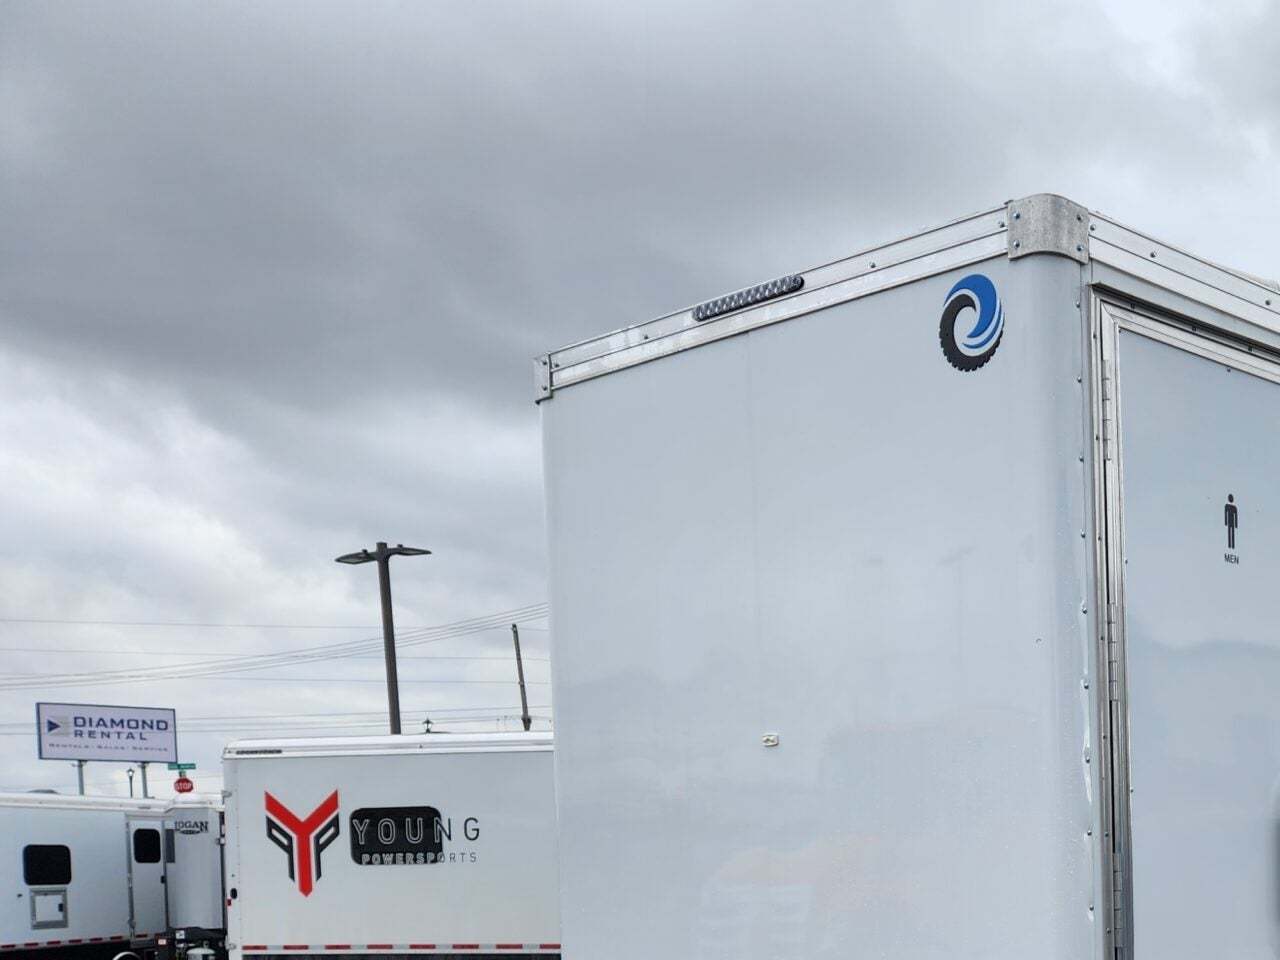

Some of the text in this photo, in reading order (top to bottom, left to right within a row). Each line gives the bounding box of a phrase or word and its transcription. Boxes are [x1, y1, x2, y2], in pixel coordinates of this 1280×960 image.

[1224, 552, 1239, 564] MEN
[73, 716, 169, 731] DIAMOND
[74, 730, 147, 741] RENTAL
[175, 782, 192, 790] STOP
[174, 820, 209, 833] LOGAN
[352, 817, 480, 845] YOUNG
[361, 852, 477, 865] POWERSPORTS
